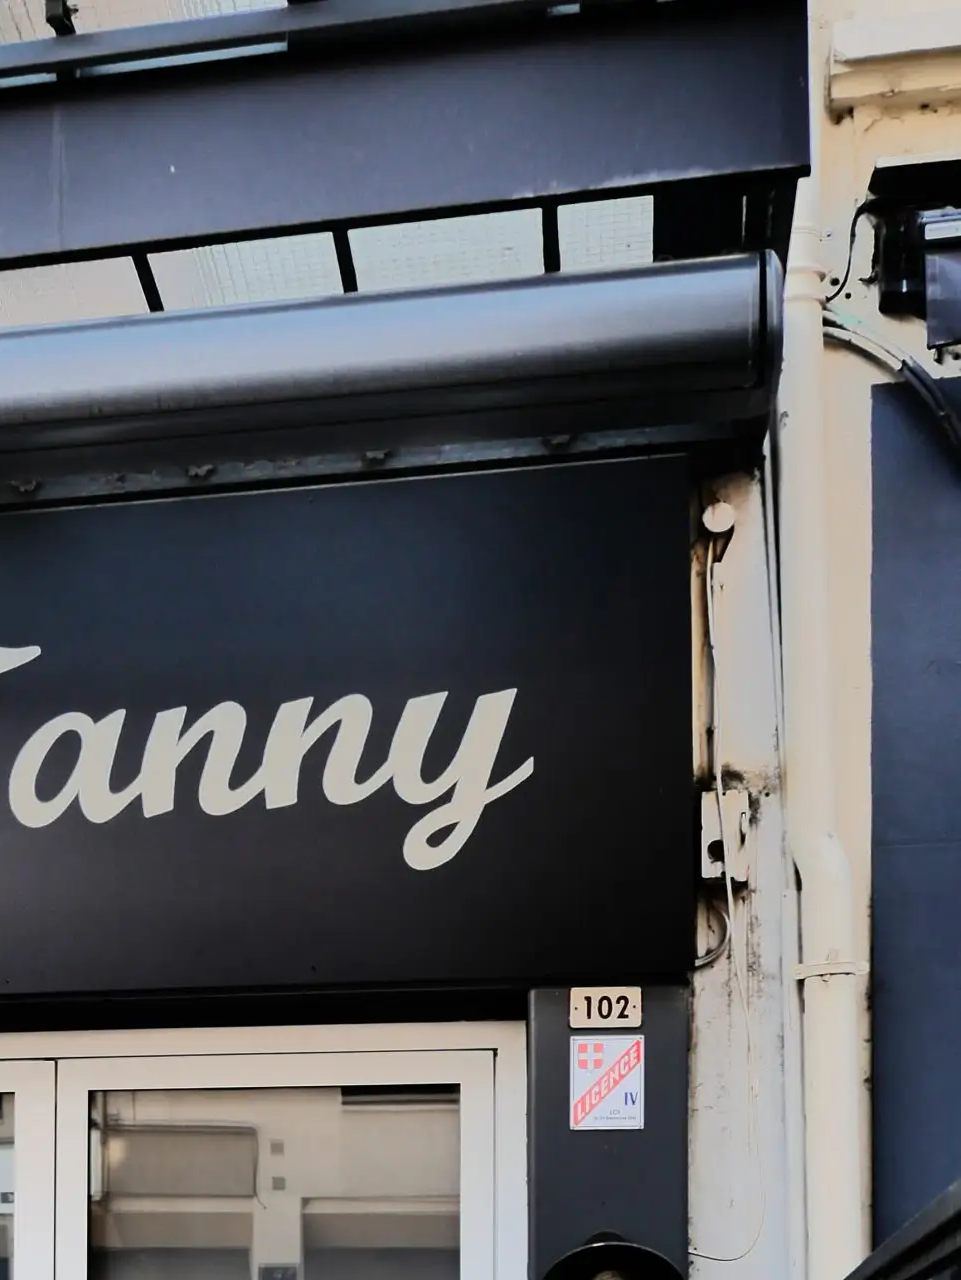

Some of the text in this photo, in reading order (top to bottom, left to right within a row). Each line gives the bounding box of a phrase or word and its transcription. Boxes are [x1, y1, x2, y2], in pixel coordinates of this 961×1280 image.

[583, 995, 630, 1020] 102
[576, 1043, 640, 1119] LICENCE
[624, 1091, 639, 1106] IV
